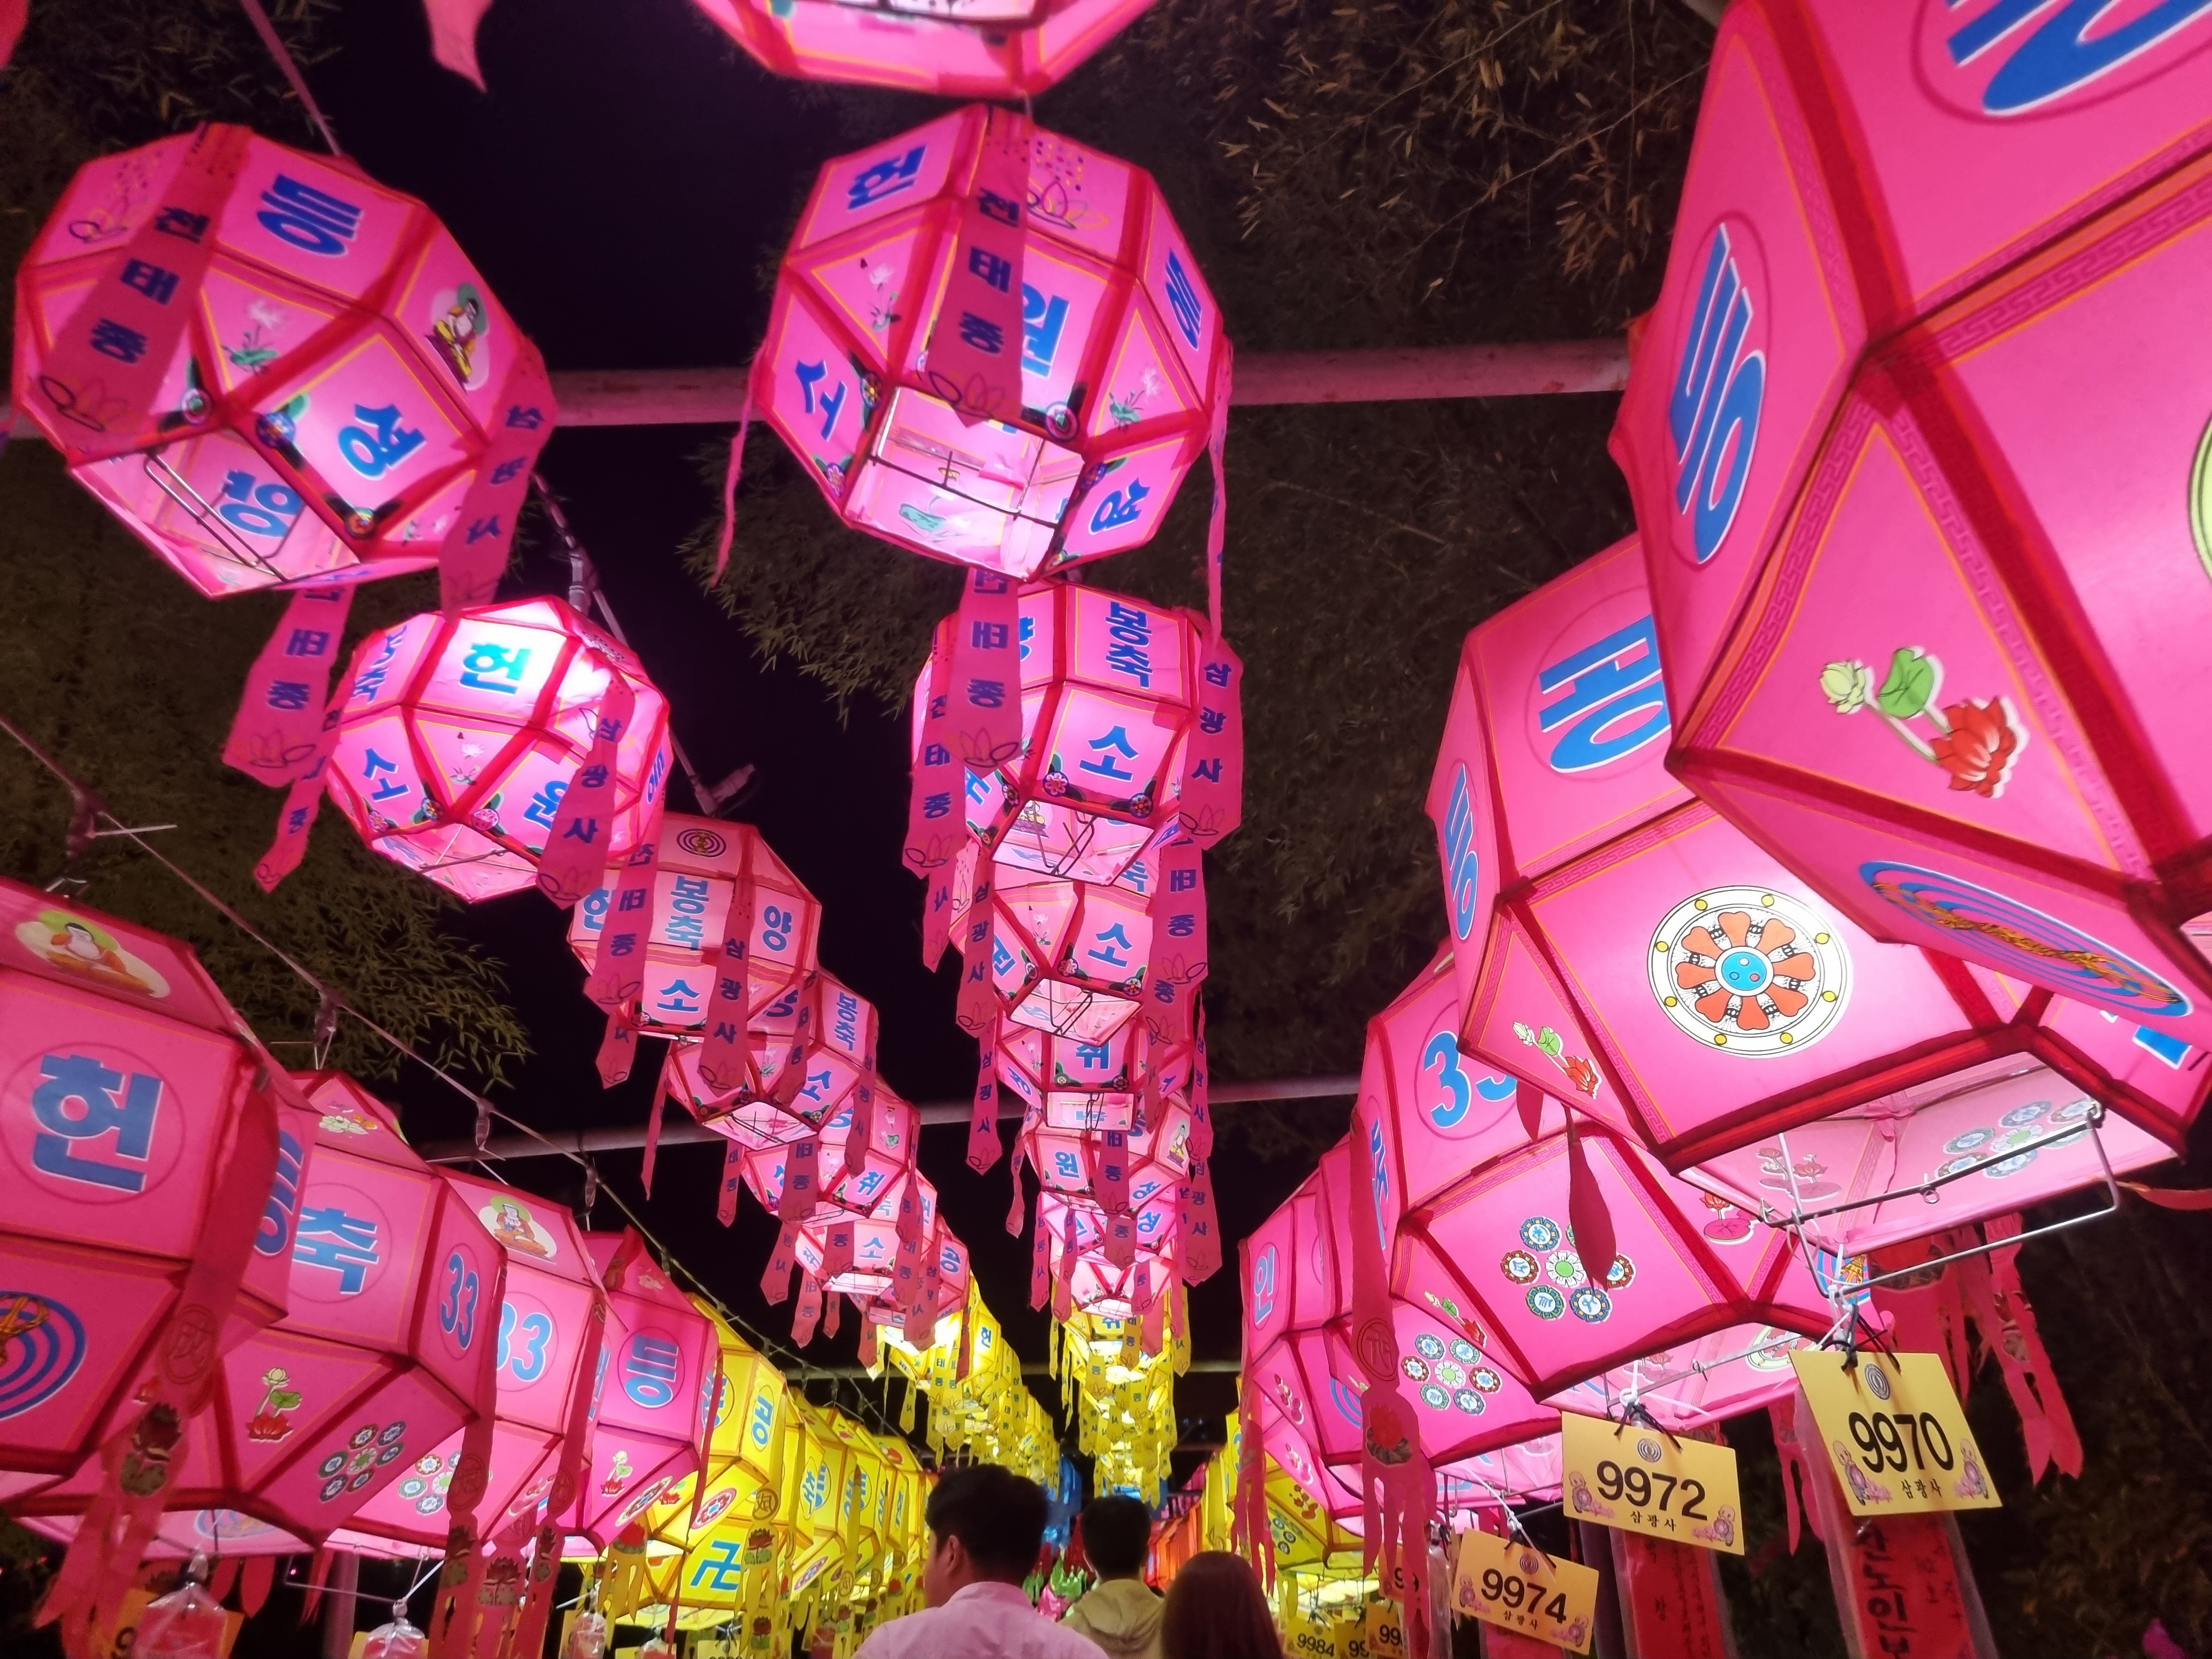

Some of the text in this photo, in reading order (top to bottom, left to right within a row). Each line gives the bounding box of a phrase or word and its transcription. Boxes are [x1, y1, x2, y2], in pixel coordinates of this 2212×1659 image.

[256, 173, 364, 258] 등
[90, 206, 210, 364] 천태종
[961, 187, 1019, 354] 천태종
[1164, 250, 1203, 350] 등
[794, 359, 848, 442] 소
[1668, 222, 1767, 565] 등
[334, 403, 427, 481] 성
[1089, 477, 1152, 535] 성
[1104, 600, 1154, 690] 봉축
[1077, 723, 1139, 782] 소
[1191, 661, 1232, 783] 삼광사
[362, 746, 410, 803] 소
[563, 716, 622, 845] 삼광사
[1442, 763, 1480, 941] 등
[664, 875, 710, 950] 봉축
[761, 905, 793, 952] 양
[967, 879, 990, 983] 삼광사
[1087, 921, 1133, 969] 소
[656, 977, 701, 1013] 소
[714, 937, 746, 1045] 삼광사
[834, 992, 859, 1052] 봉축
[799, 1069, 833, 1103] 소
[978, 1052, 993, 1134] 삼광사
[1422, 1030, 1519, 1129] 3
[31, 1054, 162, 1192] 헌
[1053, 1149, 1082, 1180] 원
[1131, 1180, 1161, 1201] 성
[859, 1236, 885, 1260] 소
[1136, 1210, 1164, 1234] 성
[441, 1252, 479, 1348] 33
[623, 1335, 676, 1408] 등
[1849, 1412, 1954, 1473] 9970
[1597, 1461, 1707, 1522] 9972
[1630, 1510, 1677, 1532] 삼광사
[1901, 1479, 1942, 1499] 삼광사
[1481, 1567, 1567, 1625] 9974
[1504, 1610, 1539, 1631] 삼광사
[1297, 1633, 1335, 1657] 9984
